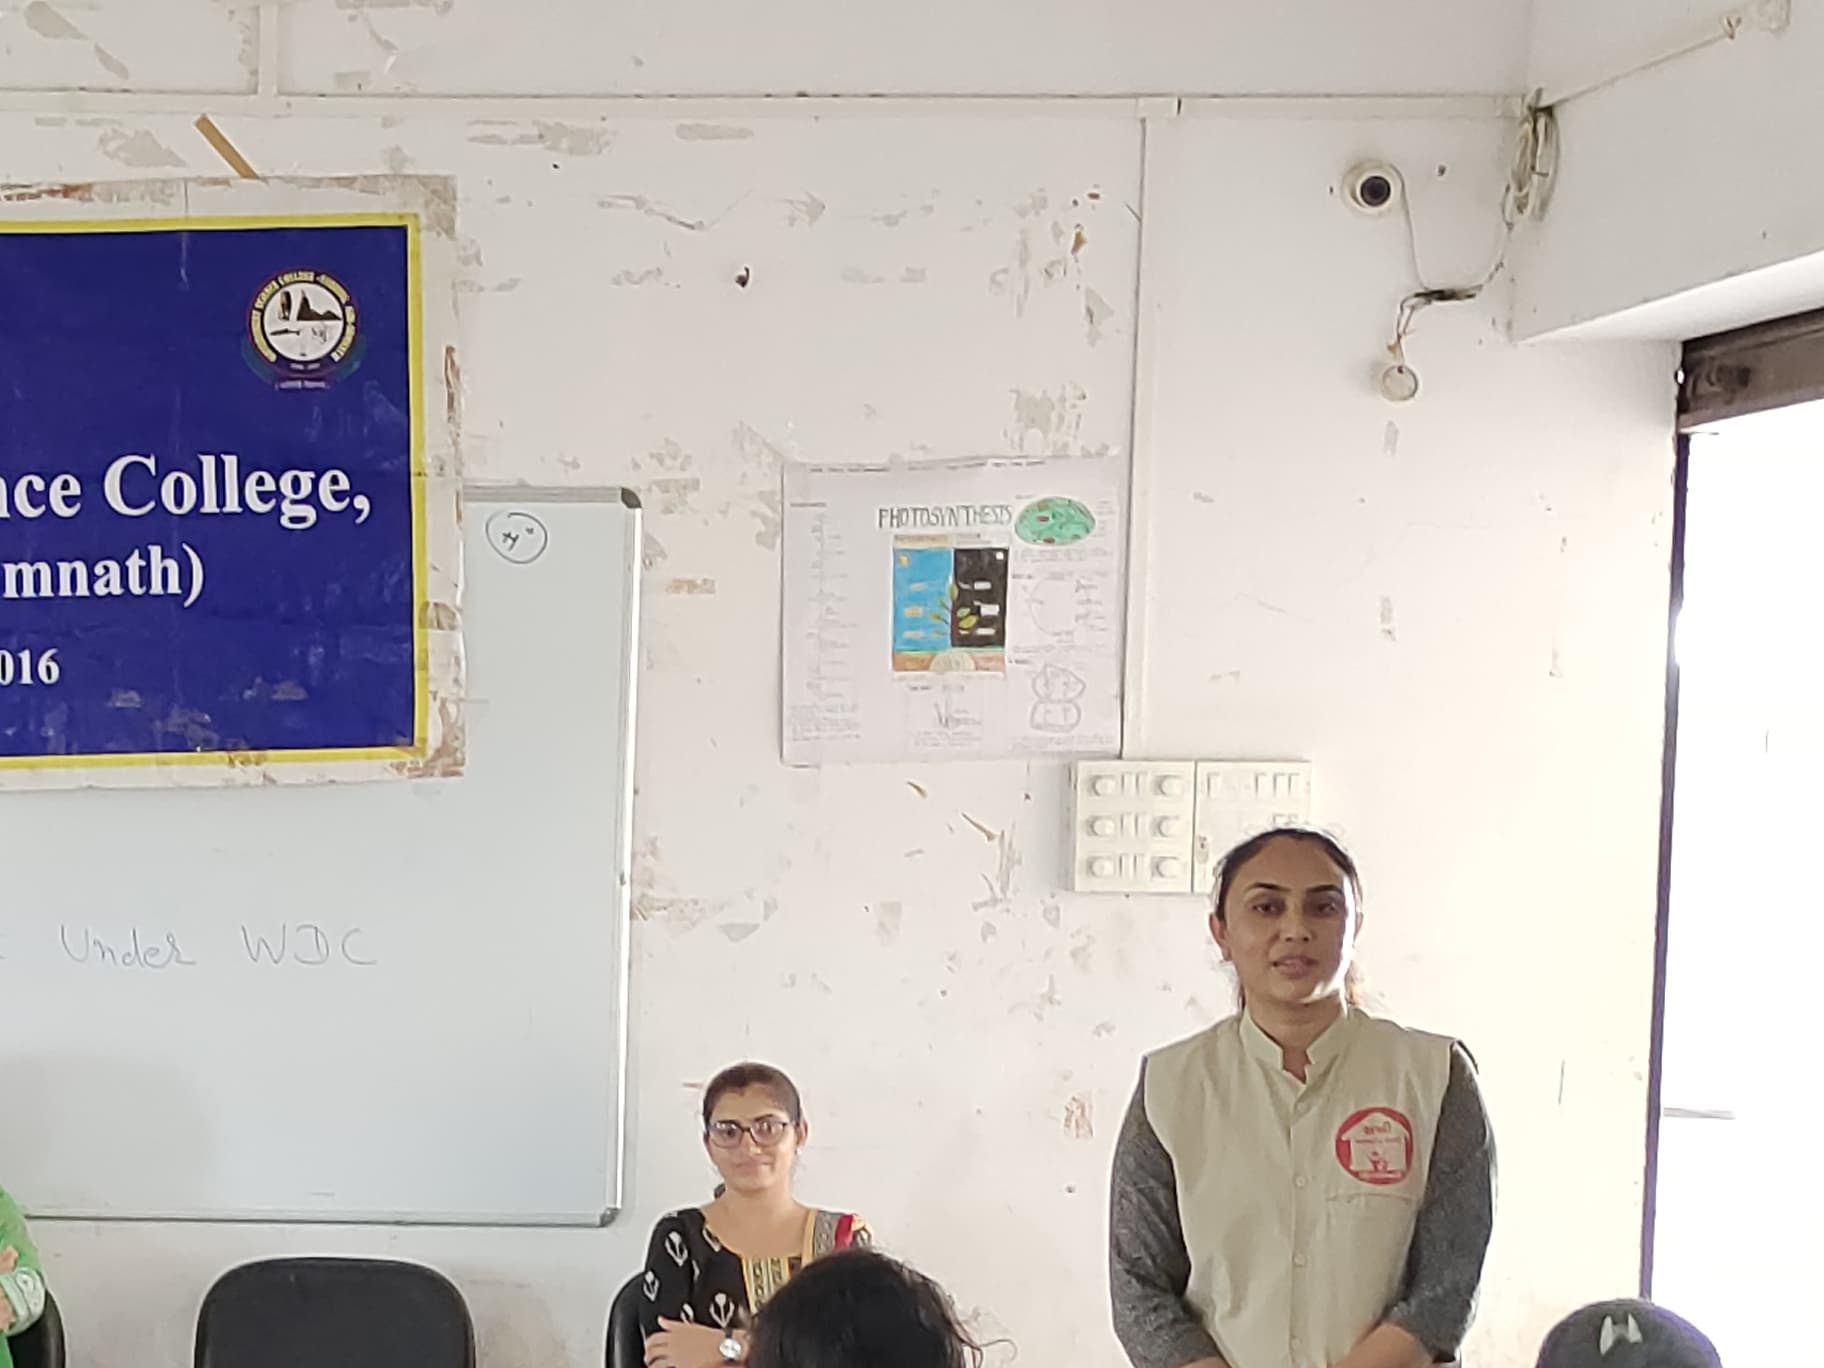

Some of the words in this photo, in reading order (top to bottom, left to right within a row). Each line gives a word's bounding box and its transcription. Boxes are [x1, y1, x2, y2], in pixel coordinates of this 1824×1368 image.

[104, 453, 371, 529] College,
[878, 505, 1012, 528] PHOTOSYNTHESIS
[60, 923, 197, 969] Under
[241, 922, 377, 966] WDC
